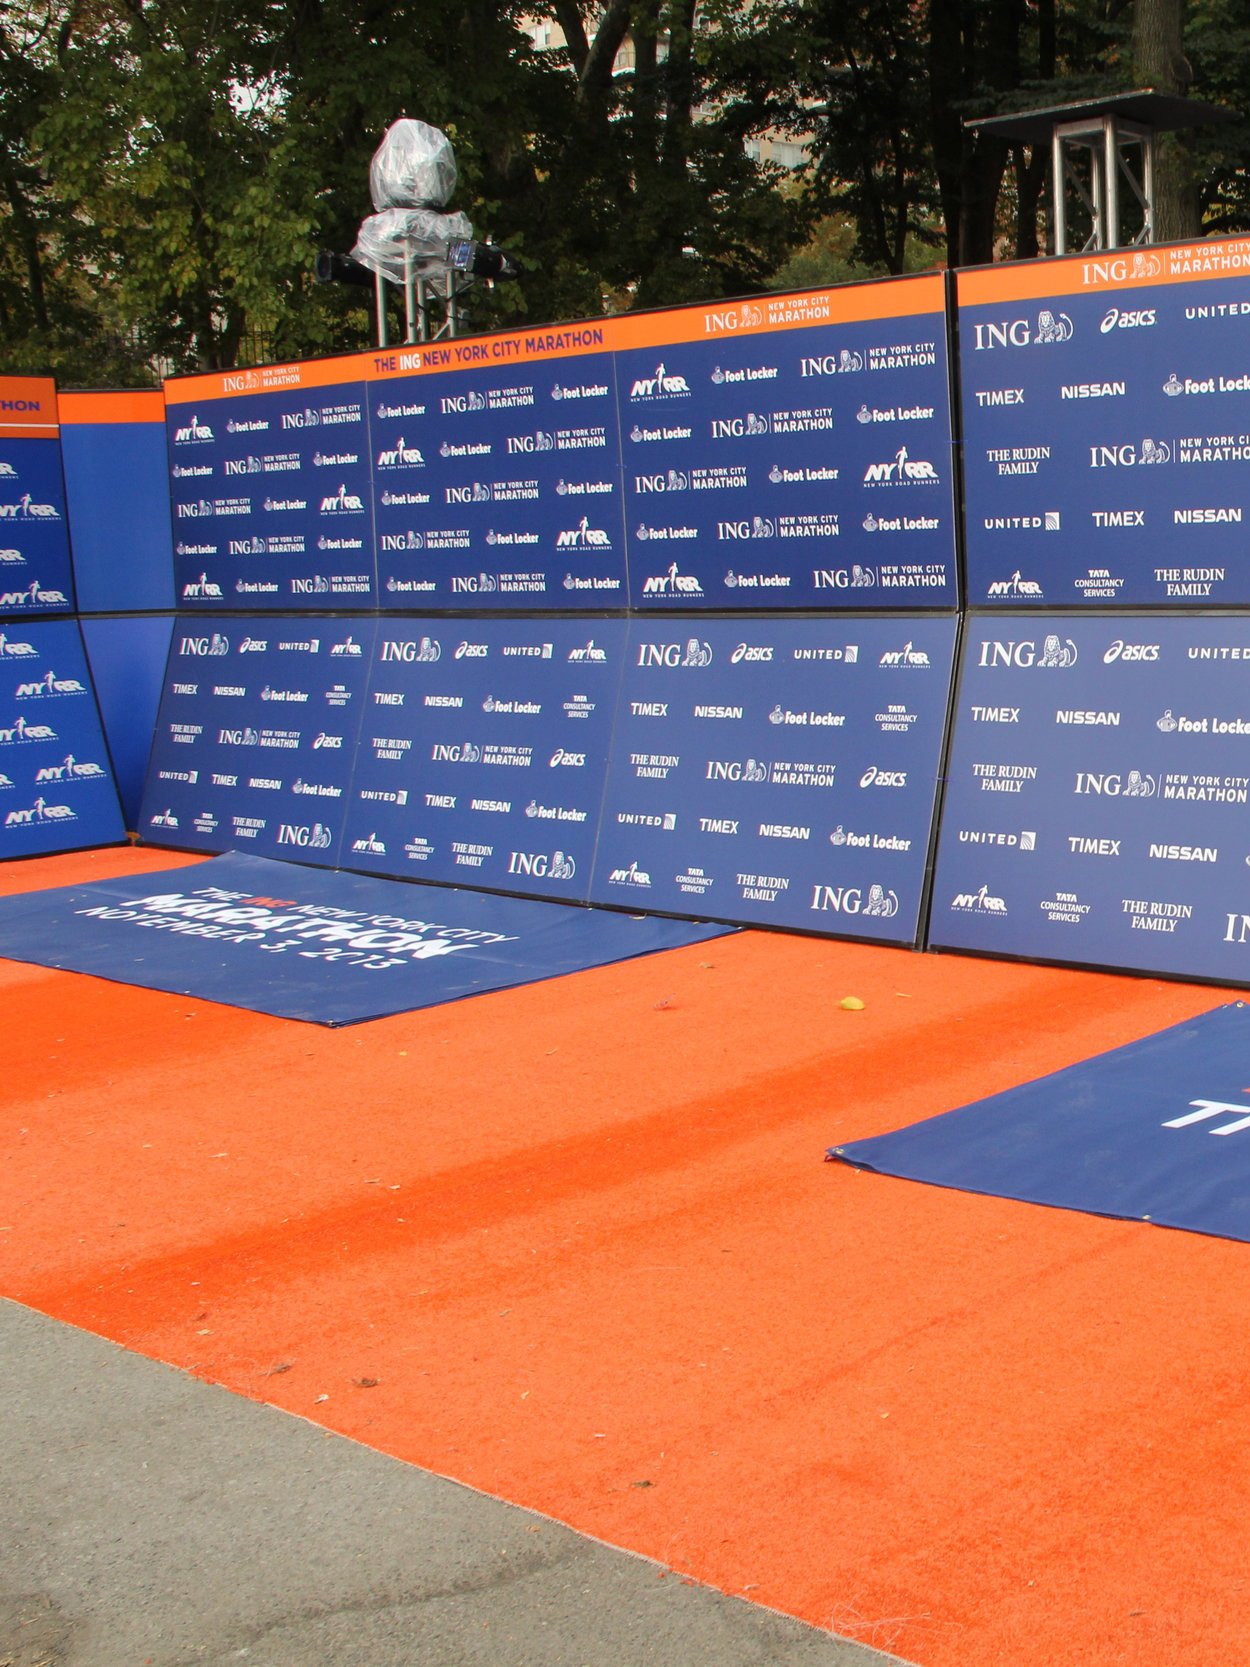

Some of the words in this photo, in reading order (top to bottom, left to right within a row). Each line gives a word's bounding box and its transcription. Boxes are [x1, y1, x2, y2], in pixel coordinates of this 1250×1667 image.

[1197, 246, 1223, 256] YORK
[1171, 251, 1250, 274] MARATHON
[1083, 261, 1126, 284] ING
[769, 304, 829, 323] MARATHON
[1186, 303, 1250, 319] UNITED
[705, 312, 737, 332] ING
[975, 320, 1030, 349] ING
[374, 357, 396, 371] THE
[400, 354, 420, 370] ING
[423, 350, 450, 365] NEW
[455, 345, 488, 361] YORK
[493, 340, 520, 357] CITY
[525, 328, 604, 355] MARATHON
[890, 345, 912, 357] YORK
[916, 343, 934, 355] CITY
[801, 356, 836, 376] ING
[870, 351, 935, 370] MARATHON
[263, 374, 300, 387] MARATHON
[725, 370, 745, 382] Foot
[747, 367, 777, 380] Locker
[224, 377, 244, 391] ING
[1185, 379, 1215, 394] Foot
[976, 389, 1024, 406] TIMEX
[249, 420, 268, 430] Locker
[450, 446, 466, 456] Foot
[467, 444, 491, 454] Locker
[508, 437, 533, 453] ING
[558, 436, 606, 450] MARATHON
[987, 450, 1010, 461] THE
[1013, 447, 1049, 460] RUDIN
[999, 462, 1039, 475] FAMILY
[180, 638, 208, 655] ING
[381, 642, 416, 661] ING
[638, 645, 681, 666] ING
[979, 642, 1035, 667] ING
[173, 684, 198, 694] TIMEX
[286, 691, 308, 701] Locker
[375, 693, 404, 705] TIMEX
[425, 696, 463, 707] NISSAN
[875, 714, 917, 725] CONSULTANCY
[631, 754, 649, 764] THE
[647, 755, 679, 766] RUDIN
[637, 767, 668, 778] FAMILY
[960, 831, 1017, 845] UNITED
[192, 887, 253, 901] THE
[287, 904, 367, 918] NEW
[358, 913, 448, 932] YORK
[436, 928, 520, 944] CITY
[119, 893, 480, 960] MARATHON
[74, 906, 266, 943] NOVEMBER
[298, 948, 408, 970] 2013
